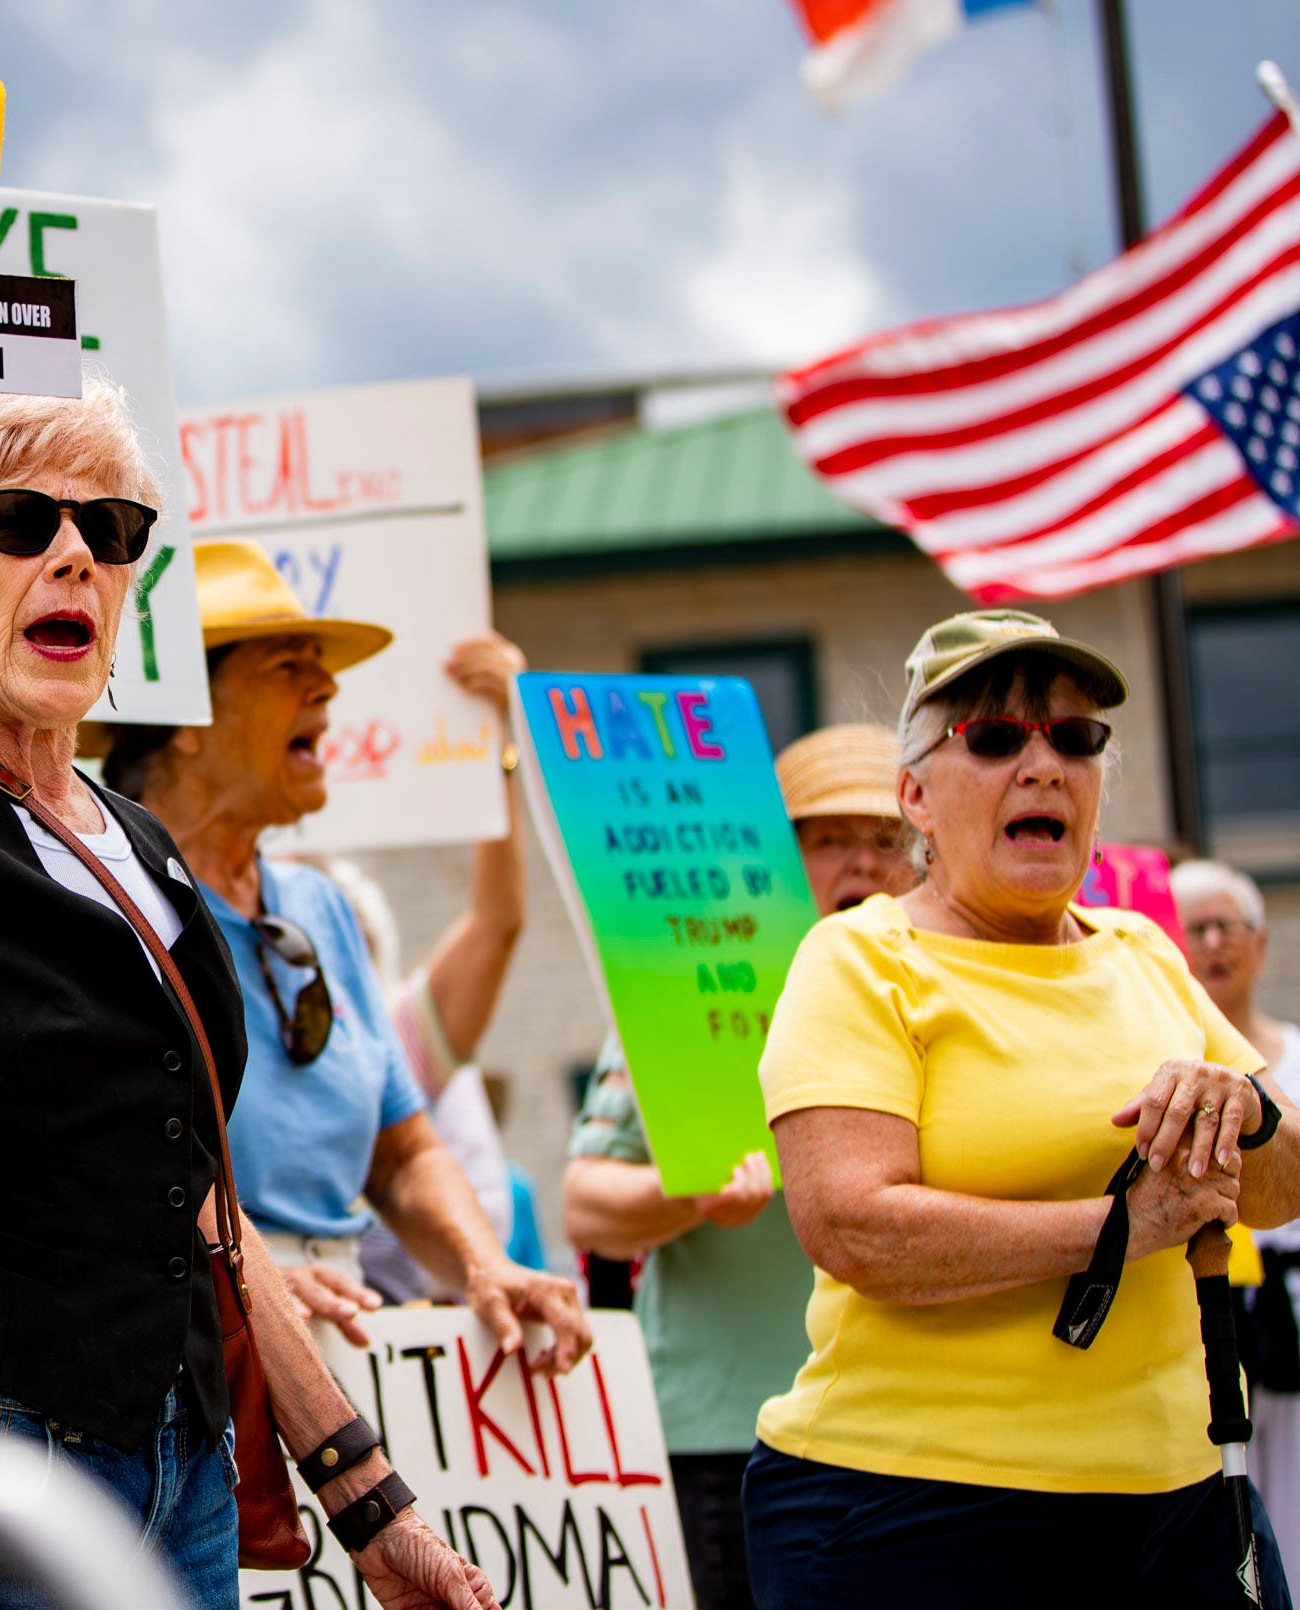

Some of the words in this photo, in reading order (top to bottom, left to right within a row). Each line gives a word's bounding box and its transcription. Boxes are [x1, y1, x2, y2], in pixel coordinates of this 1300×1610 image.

[11, 303, 52, 328] OVER
[548, 686, 726, 762] HATE
[618, 776, 653, 809] IS
[665, 778, 704, 805] AN
[604, 822, 762, 854] ADDICTION
[622, 868, 731, 901] FUELED
[742, 868, 774, 898] BY
[666, 912, 758, 948] TRUMP
[695, 960, 758, 994] AND
[456, 1334, 662, 1490] KILL
